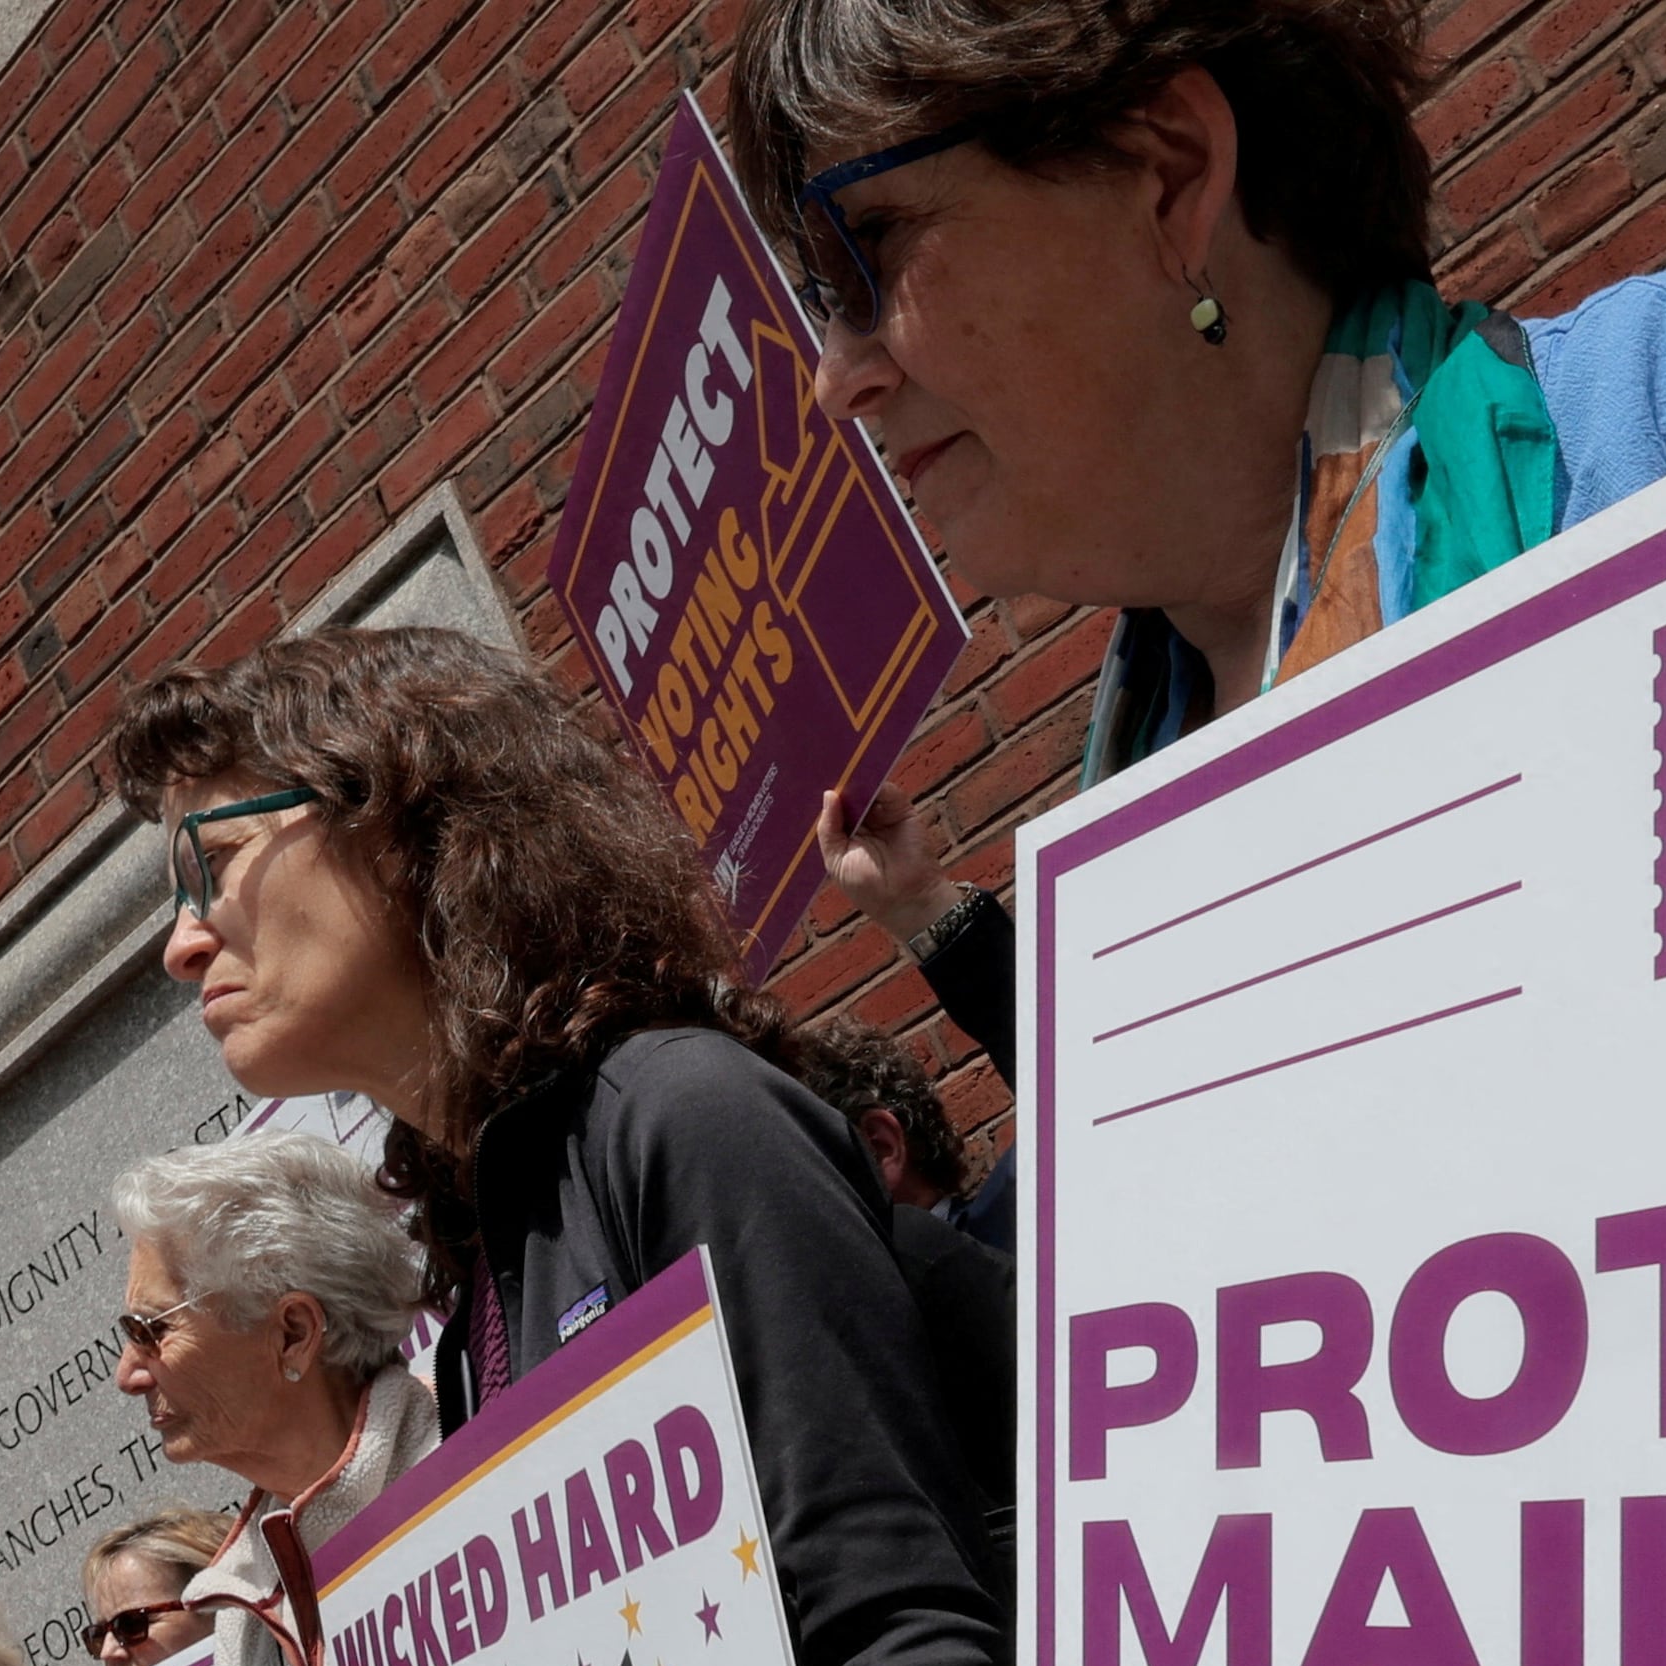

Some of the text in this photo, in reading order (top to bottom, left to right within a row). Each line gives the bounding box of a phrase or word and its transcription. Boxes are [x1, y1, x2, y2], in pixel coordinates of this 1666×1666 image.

[594, 275, 755, 699] PROTECT
[639, 505, 761, 776] VOTING
[673, 599, 795, 849] RIGHTS
[559, 1303, 606, 1343] patagonia
[119, 1434, 162, 1482] TH
[512, 1403, 724, 1622] HARD
